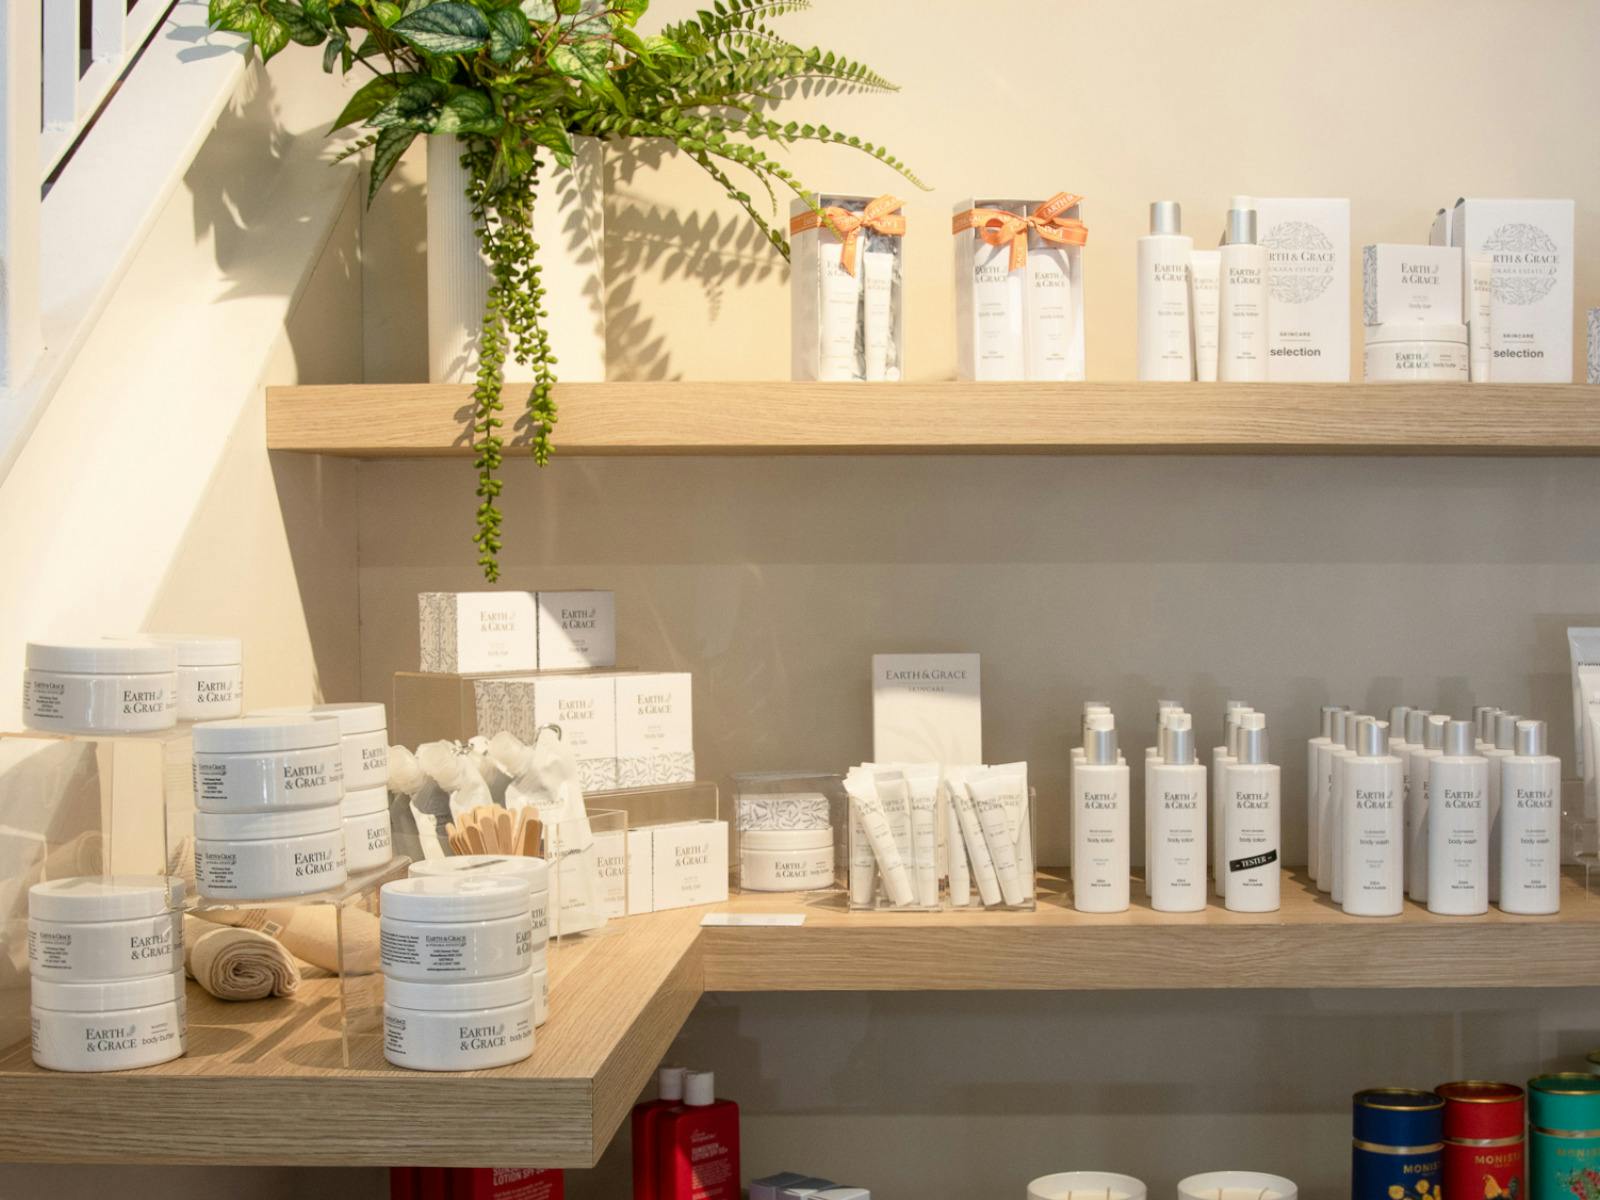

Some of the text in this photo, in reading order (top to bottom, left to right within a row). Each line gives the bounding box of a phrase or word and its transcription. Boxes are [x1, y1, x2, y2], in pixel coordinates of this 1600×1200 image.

[1268, 252, 1336, 262] RTH & GRACE
[1493, 254, 1560, 264] RTH & GRACE
[1154, 264, 1182, 272] EARTH
[1230, 268, 1256, 276] EARTH
[1402, 263, 1430, 274] EARTH
[1034, 272, 1058, 280] EARTH
[1237, 276, 1261, 284] GRACE
[1402, 274, 1440, 284] & GRACE
[1042, 280, 1066, 288] GRACE
[1270, 346, 1322, 357] selection
[1396, 352, 1422, 361] EARTH
[1494, 348, 1544, 358] selection
[1402, 361, 1430, 369] GRACE
[480, 611, 508, 620] EARTH
[562, 608, 588, 619] EARTH
[489, 622, 515, 632] GRACE
[569, 618, 596, 629] GRACE
[198, 680, 226, 691] EARTH
[124, 690, 156, 701] EARTH
[198, 692, 232, 703] & GRACE
[638, 694, 664, 704] EARTH
[124, 702, 164, 714] & GRACE
[558, 700, 586, 710] EARTH
[646, 704, 672, 714] GRACE
[567, 710, 595, 720] GRACE
[284, 766, 318, 778] EARTH
[285, 776, 326, 790] & GRACE
[1084, 792, 1109, 800] EARTH
[1164, 792, 1190, 800] EARTH
[1236, 792, 1262, 800] EARTH
[1356, 790, 1384, 800] EARTH
[1444, 789, 1474, 798] EARTH
[1516, 789, 1546, 798] EARTH
[1364, 800, 1394, 808] GRACE
[1453, 800, 1481, 808] GRACE
[1525, 800, 1552, 808] GRACE
[675, 846, 702, 856] EARTH
[294, 850, 328, 865] EARTH
[682, 856, 708, 866] GRACE
[1241, 856, 1266, 868] TESTER
[295, 861, 334, 876] & GRACE
[776, 862, 800, 870] EARTH
[782, 870, 808, 878] GRACE
[131, 935, 164, 948] EARTH
[132, 946, 172, 960] & GRACE
[86, 1027, 125, 1040] EARTH
[460, 1026, 497, 1039] EARTH
[87, 1042, 95, 1052] &
[98, 1038, 137, 1051] GRACE
[460, 1042, 468, 1050] &
[471, 1038, 506, 1050] GRACE
[493, 1171, 522, 1186] LOTION
